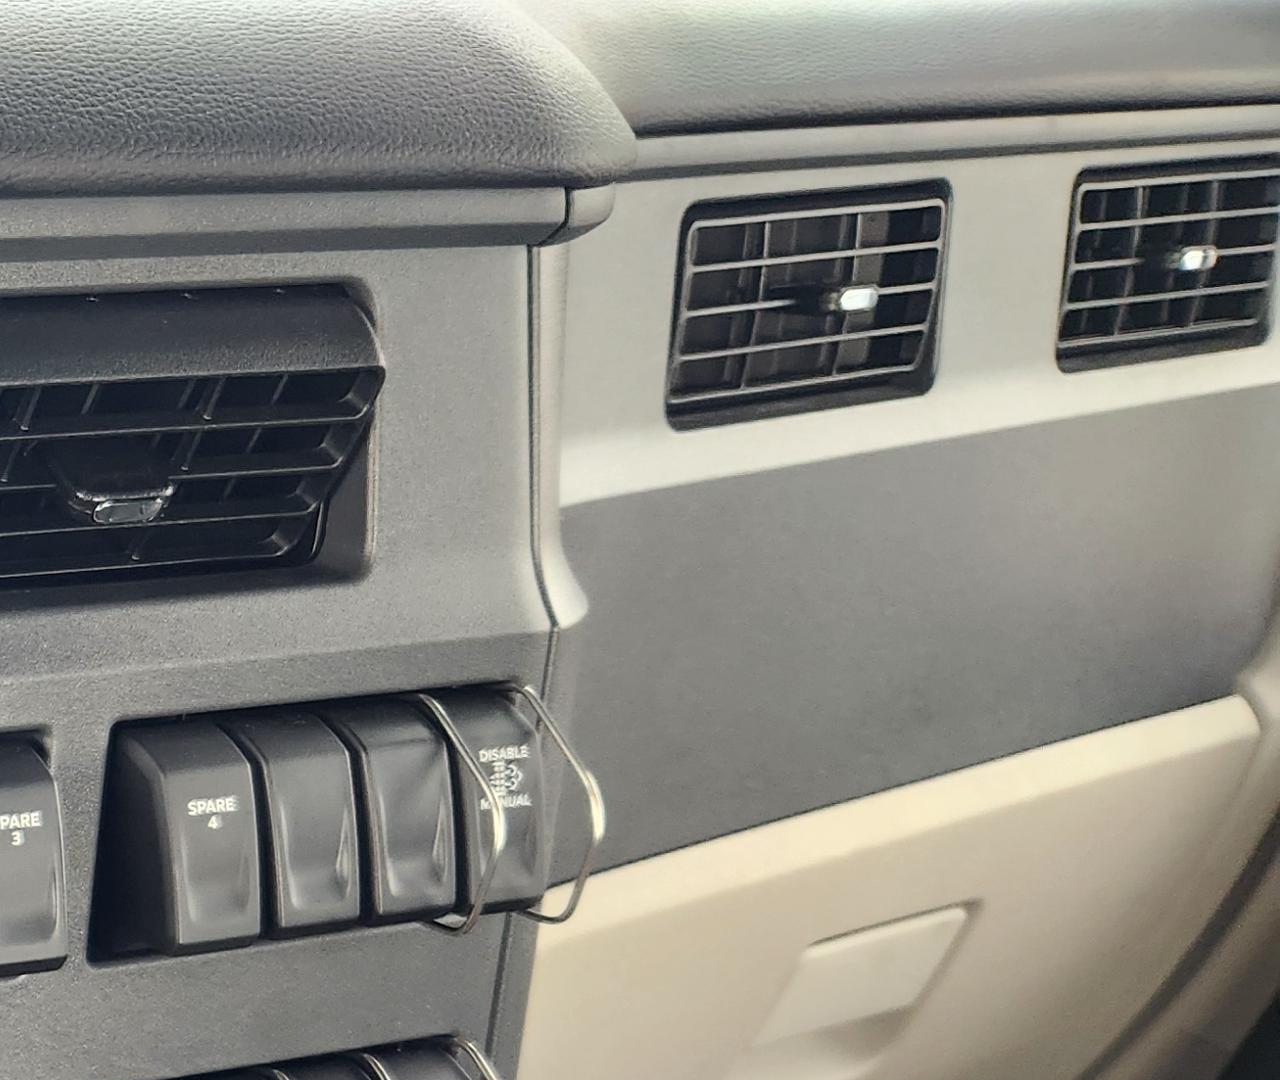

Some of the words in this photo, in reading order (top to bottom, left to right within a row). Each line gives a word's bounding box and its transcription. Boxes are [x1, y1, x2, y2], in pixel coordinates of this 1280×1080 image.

[479, 744, 529, 762] DISABLE
[187, 796, 236, 816] SPARE
[480, 793, 532, 810] MNUAL
[207, 814, 222, 830] 4
[11, 831, 25, 846] 3
